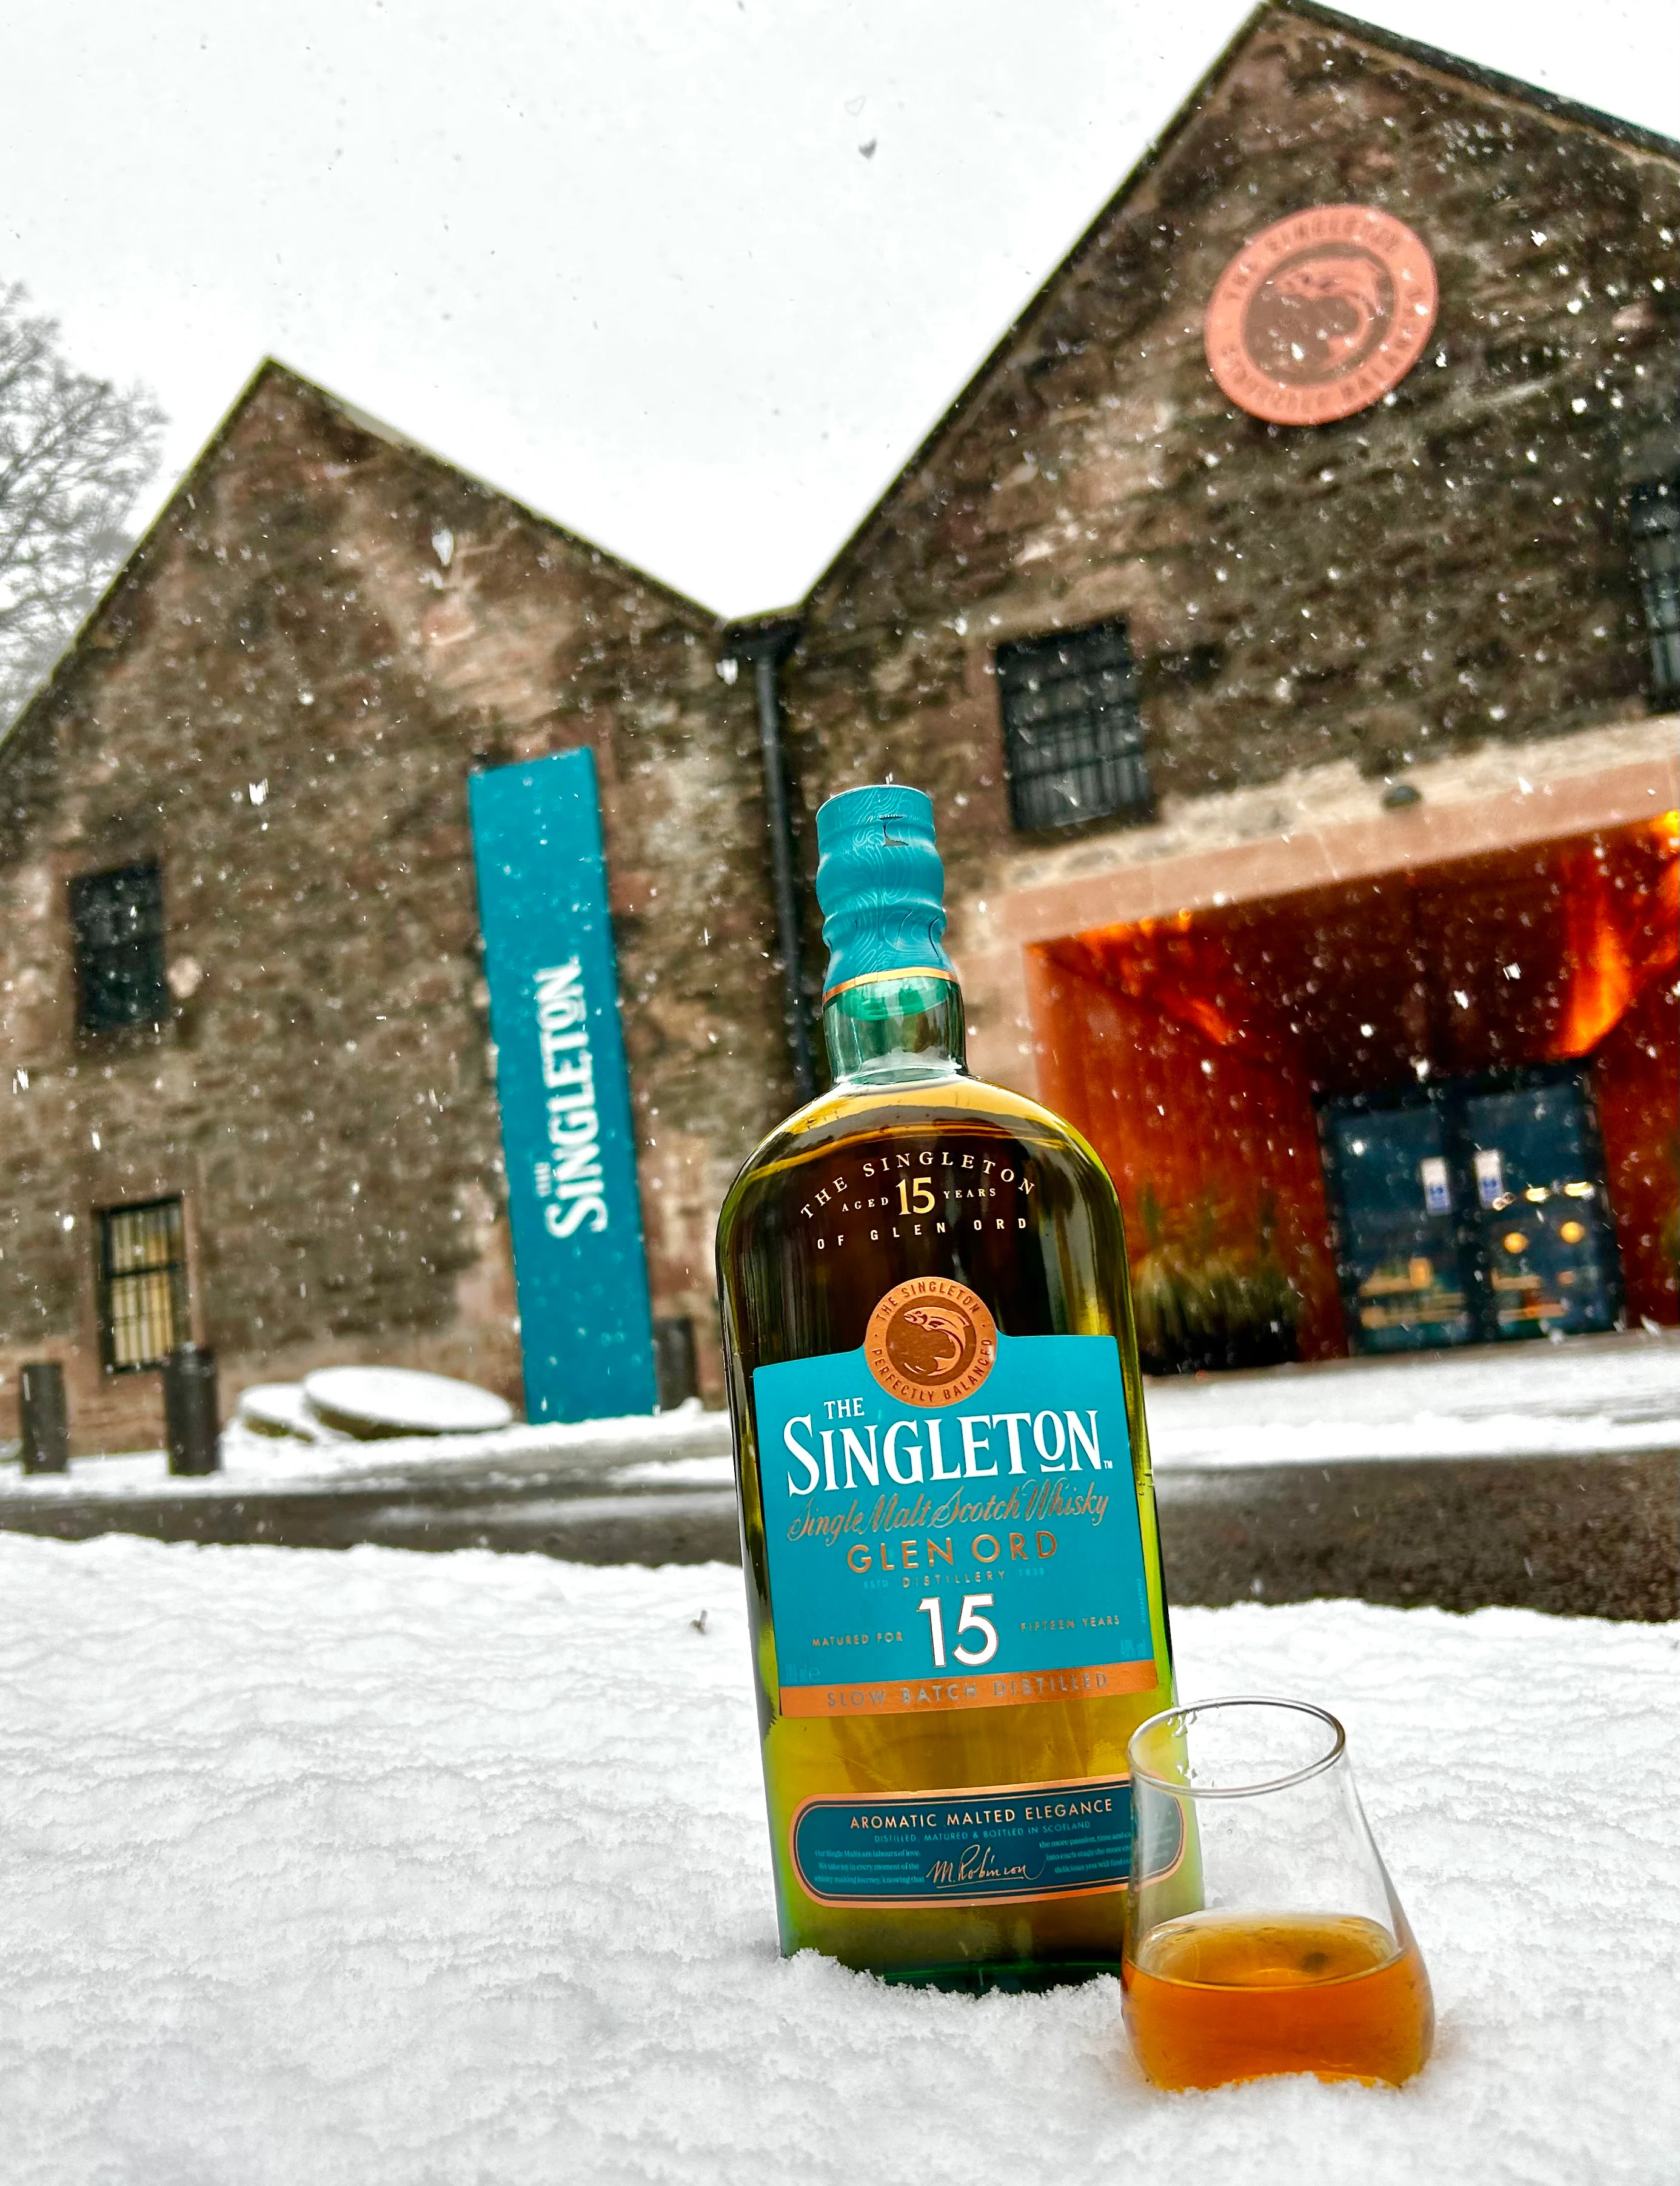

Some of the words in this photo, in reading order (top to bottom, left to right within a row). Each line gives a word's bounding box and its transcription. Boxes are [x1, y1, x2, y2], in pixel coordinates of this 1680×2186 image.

[533, 961, 607, 1238] SINGLETON
[800, 1177, 848, 1219] THE
[863, 1151, 1035, 1195] SINGLETON
[842, 1197, 889, 1212] AGED
[895, 1177, 935, 1215] 15
[943, 1188, 996, 1199] YEARS
[817, 1235, 844, 1249] OF
[870, 1222, 946, 1241] GLEN
[973, 1218, 1026, 1231] ORD
[875, 1296, 899, 1321] THE
[902, 1281, 980, 1314] SINGLETON
[872, 1349, 934, 1402] PERFECTLY
[943, 1339, 992, 1400] BALANCED
[823, 1397, 865, 1420] THE
[783, 1409, 1102, 1497] SINGLETON
[787, 1496, 862, 1547] Single
[859, 1492, 932, 1535] Malt
[927, 1485, 1022, 1528] Scotch
[1021, 1477, 1109, 1526] Whisky
[847, 1537, 954, 1574] GLEN
[971, 1530, 1057, 1564] ORD
[902, 1569, 1005, 1588] DISTILLERY
[812, 1634, 869, 1646] MATURED
[877, 1631, 903, 1643] FOR
[916, 1593, 999, 1668] 15
[1020, 1619, 1076, 1633] FIFTEEN
[1082, 1614, 1120, 1627] YEARS
[827, 1689, 886, 1708] SLOW
[900, 1682, 977, 1704] BATCH
[993, 1672, 1108, 1697] DISTILLED
[849, 1813, 937, 1830] AROMATIC
[946, 1808, 1016, 1826] MALTED
[1025, 1798, 1113, 1821] ELEGANCE
[924, 1830, 969, 1842] MATURED
[972, 1831, 979, 1839] &
[983, 1827, 1025, 1838] BOTTLED
[1027, 1825, 1039, 1834] IN
[1042, 1820, 1091, 1834] SCOTLAND
